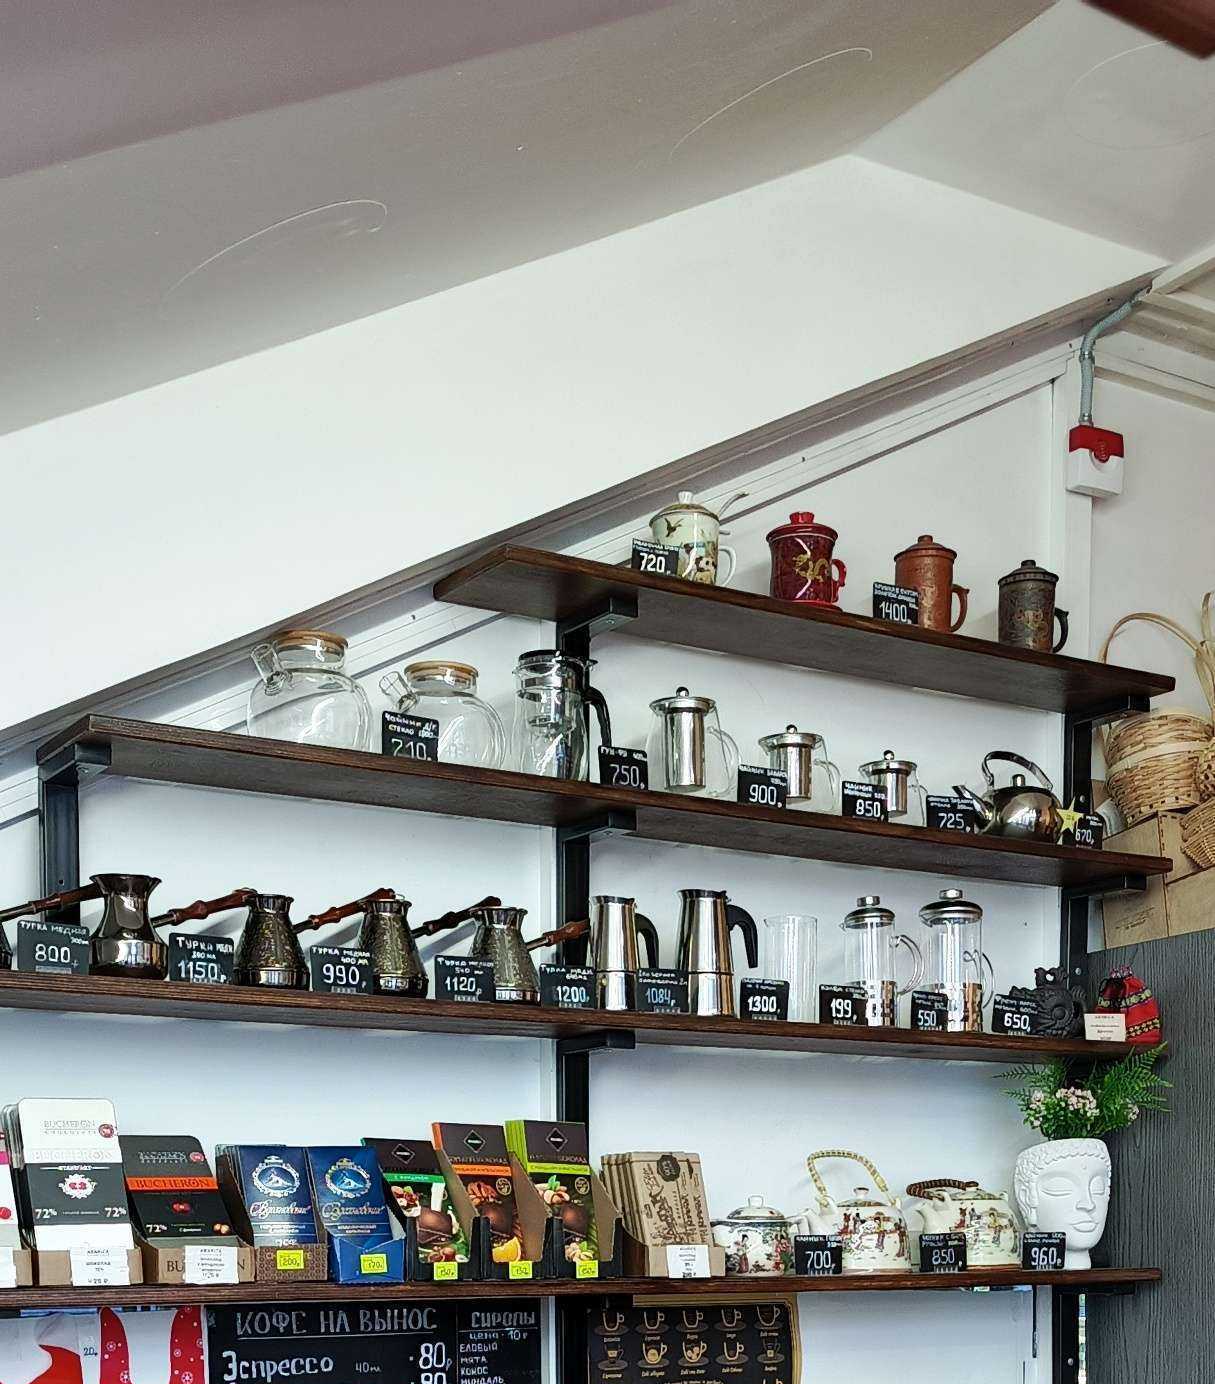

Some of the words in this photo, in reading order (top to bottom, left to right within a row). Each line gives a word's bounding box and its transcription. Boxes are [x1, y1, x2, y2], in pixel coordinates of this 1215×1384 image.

[237, 1311, 307, 1335] КОФЕ
[320, 1310, 350, 1333] НА
[360, 1307, 438, 1332] ВЫНОС
[471, 1311, 535, 1328] СИРОПЫ
[223, 1350, 334, 1382] Эспрессо
